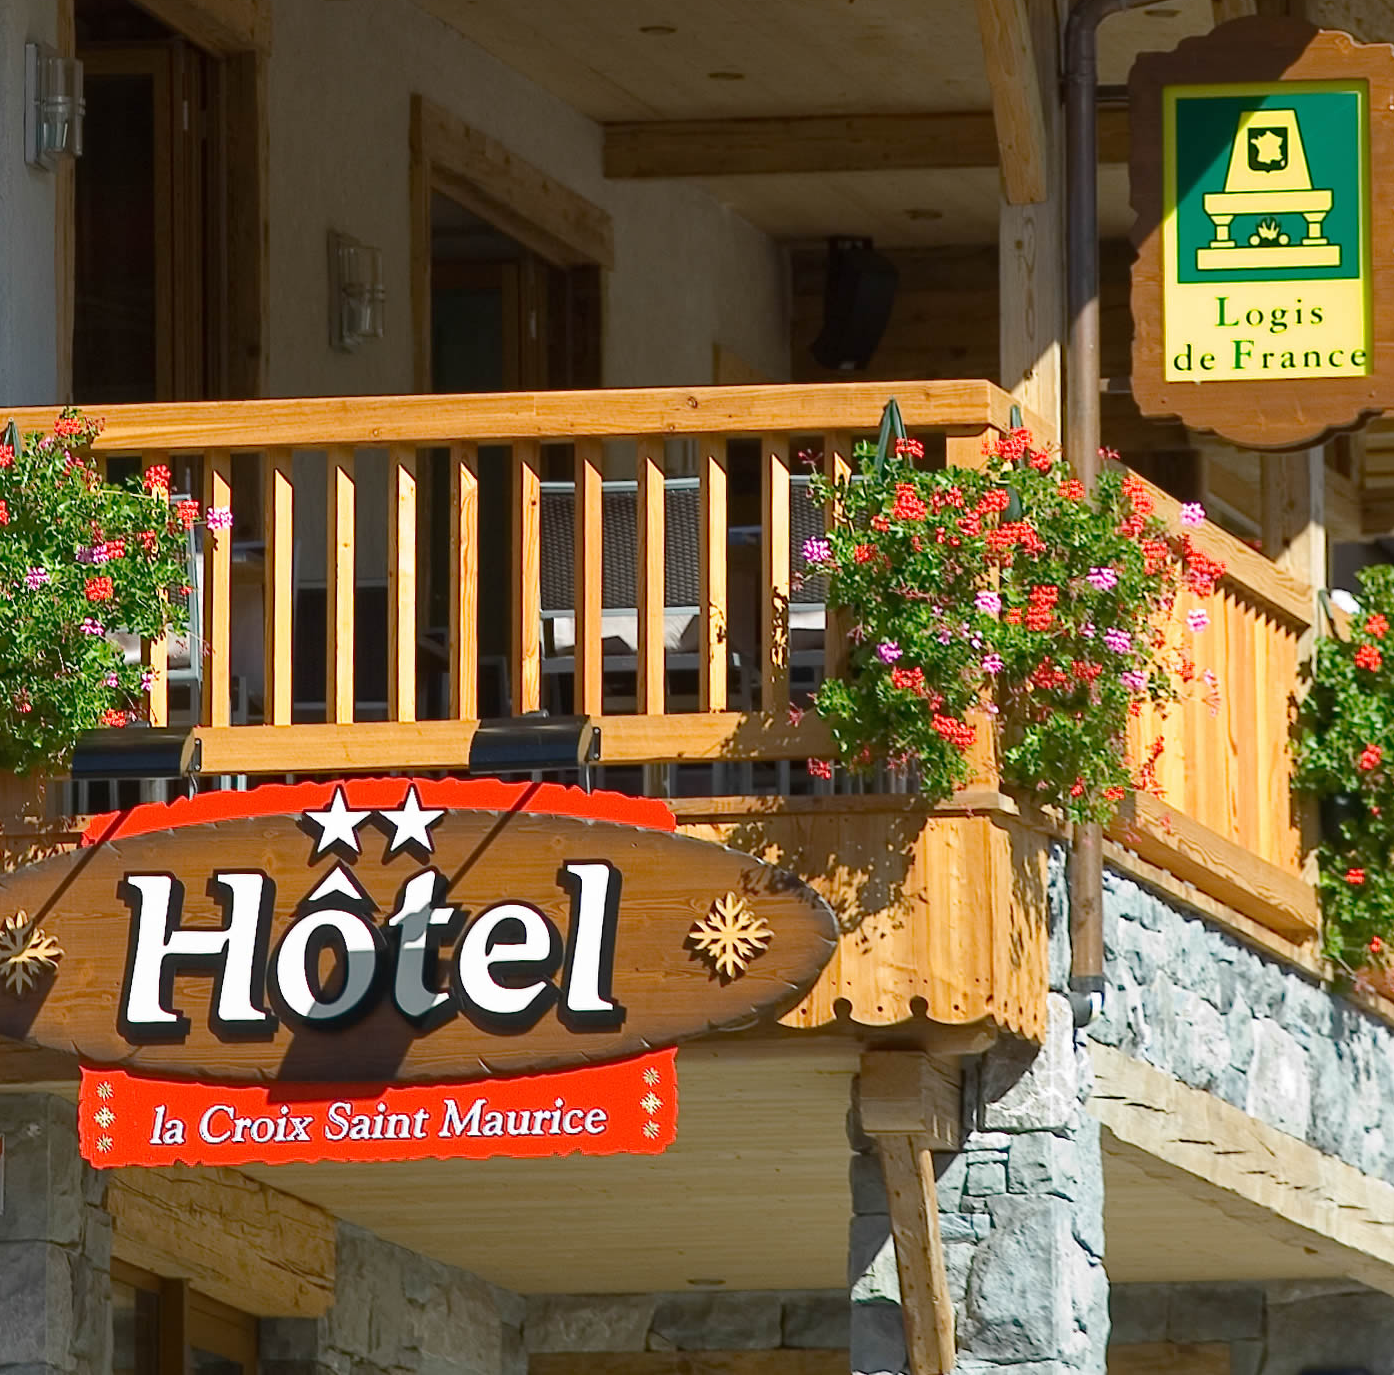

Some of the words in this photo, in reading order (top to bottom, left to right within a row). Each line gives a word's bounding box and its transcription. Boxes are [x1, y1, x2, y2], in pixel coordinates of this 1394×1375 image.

[1214, 295, 1324, 335] Logis
[1172, 343, 1216, 372] de
[1230, 338, 1368, 371] France
[124, 861, 616, 1026] Hôtel
[149, 1103, 187, 1146] la
[198, 1103, 314, 1145] Croix
[324, 1100, 431, 1142] Saint
[437, 1096, 608, 1139] Maurice
